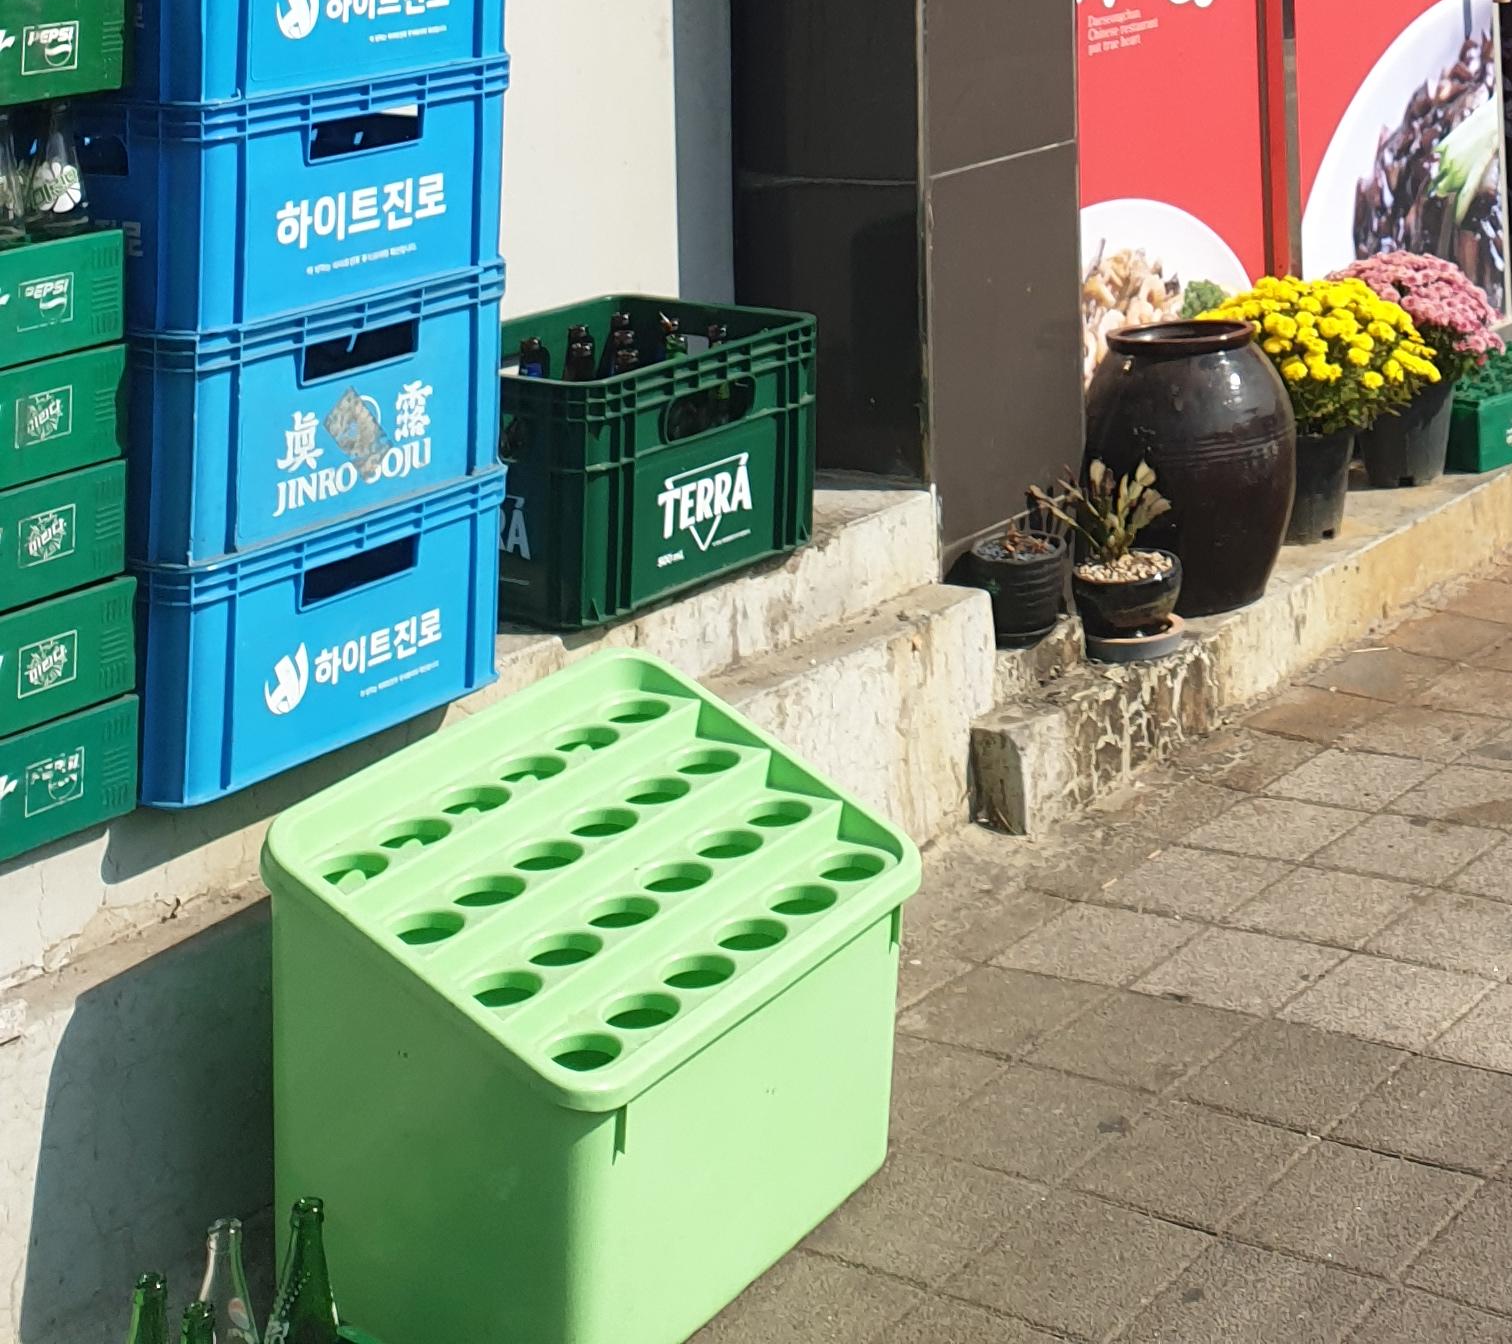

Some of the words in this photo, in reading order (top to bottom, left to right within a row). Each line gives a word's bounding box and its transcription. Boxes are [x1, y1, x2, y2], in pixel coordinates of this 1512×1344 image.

[27, 25, 75, 47] PEPSI
[276, 172, 447, 249] 하이트진로
[25, 278, 70, 299] PEPSI
[272, 461, 358, 518] JINRO
[657, 464, 753, 540] TERRA
[314, 607, 443, 686] 하이트진로
